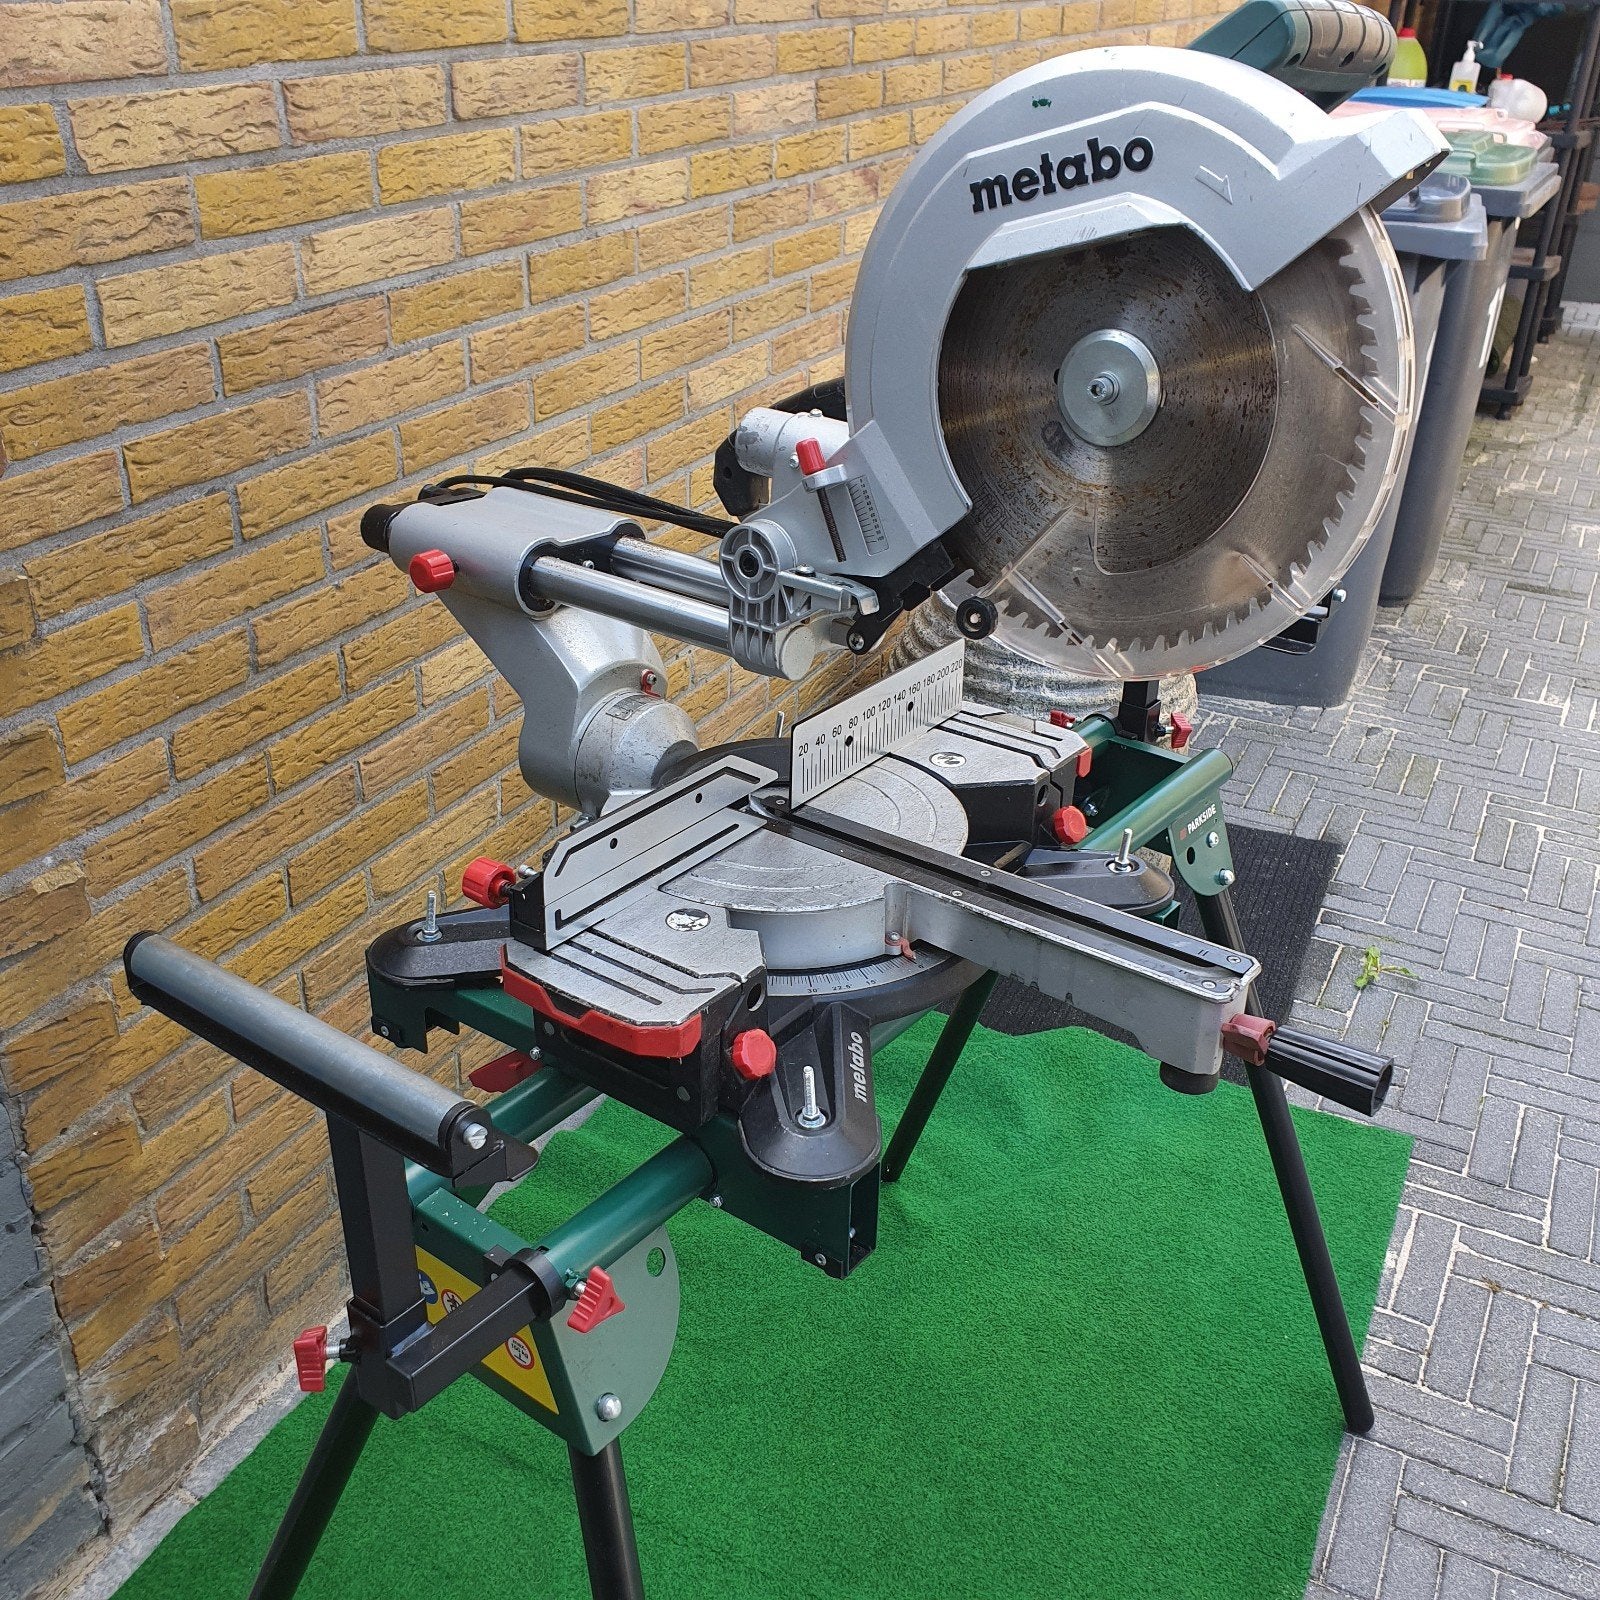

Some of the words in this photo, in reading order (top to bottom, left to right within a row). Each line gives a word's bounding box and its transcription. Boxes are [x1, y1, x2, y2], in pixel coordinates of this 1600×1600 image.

[969, 136, 1154, 214] metabo
[798, 743, 809, 757] 20
[815, 733, 826, 746] 40
[832, 724, 842, 738] 60
[848, 716, 858, 729] 80
[862, 706, 876, 721] 100
[877, 697, 891, 713] 120
[893, 689, 906, 704] 140
[908, 681, 921, 695] 160
[923, 673, 936, 688] 180
[936, 665, 950, 680] 200
[950, 658, 963, 673] 220
[1187, 803, 1217, 834] PARKSIDE
[847, 1031, 868, 1103] metabo
